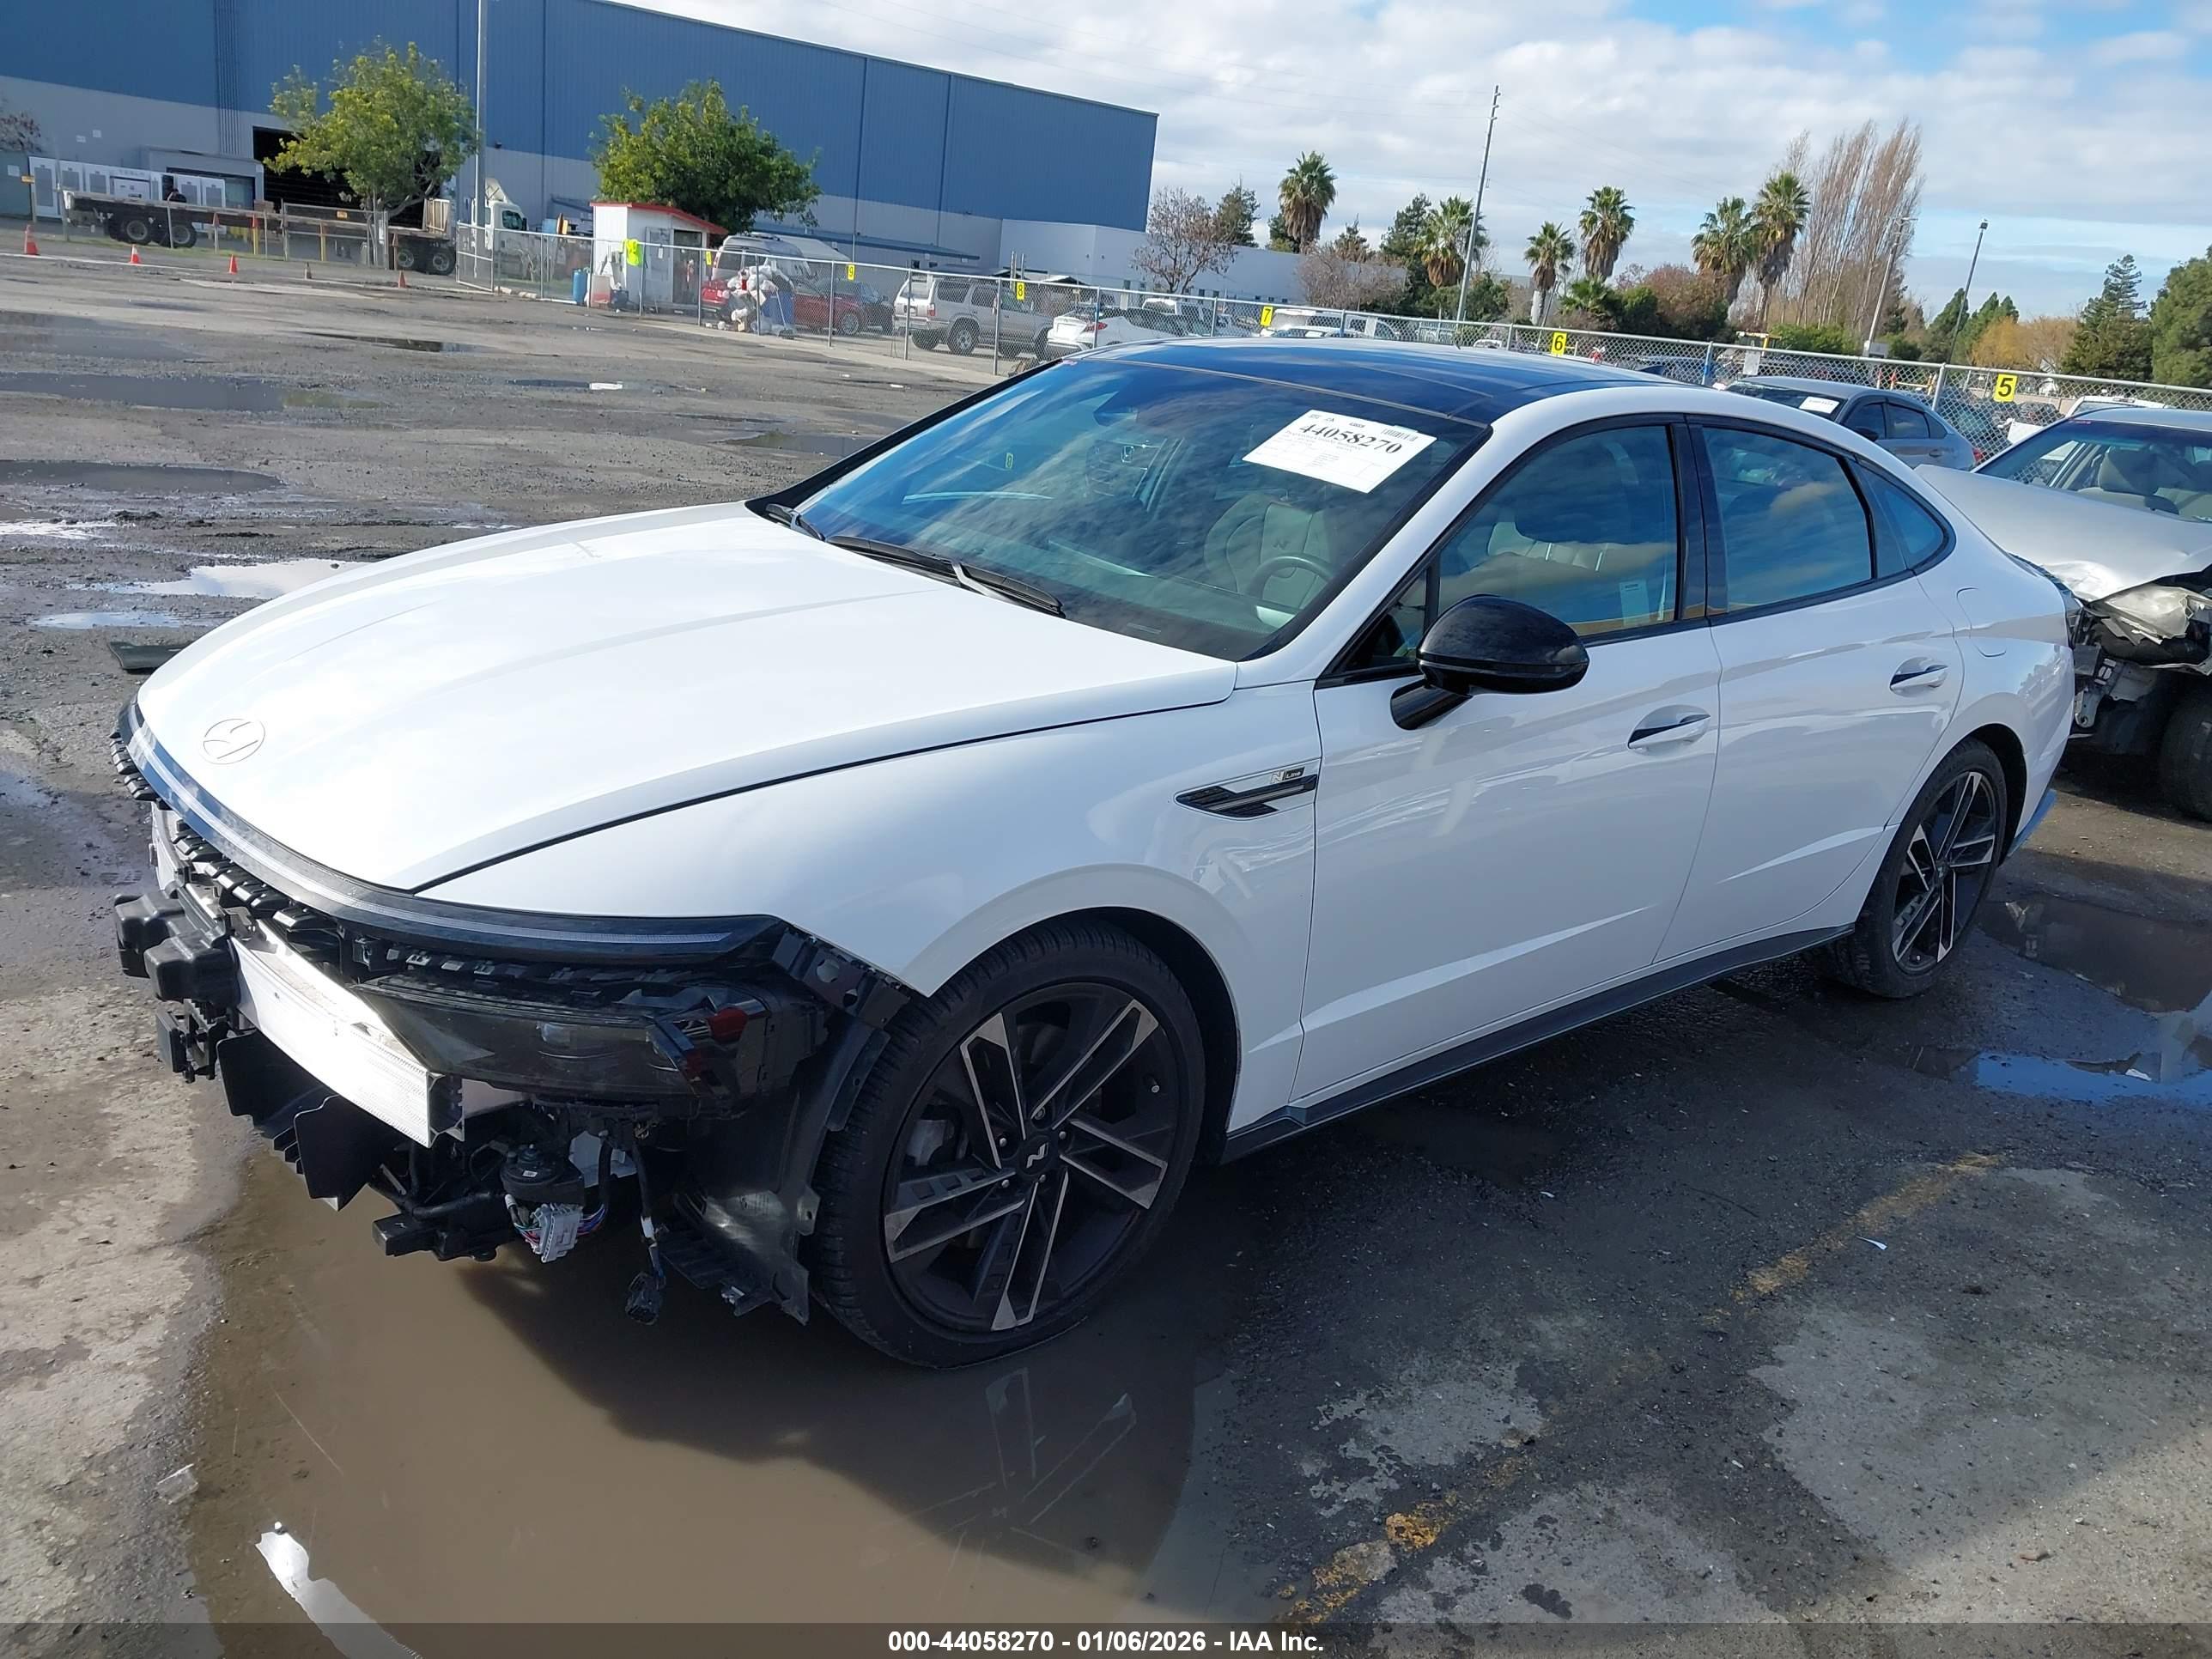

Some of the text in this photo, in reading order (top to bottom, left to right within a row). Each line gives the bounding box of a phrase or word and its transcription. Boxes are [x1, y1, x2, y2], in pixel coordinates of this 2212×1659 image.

[1018, 284, 1024, 296] 8
[1264, 308, 1272, 322] 7
[1554, 335, 1565, 351] 6
[1998, 378, 2014, 397] 5
[1298, 423, 1403, 454] 44058270
